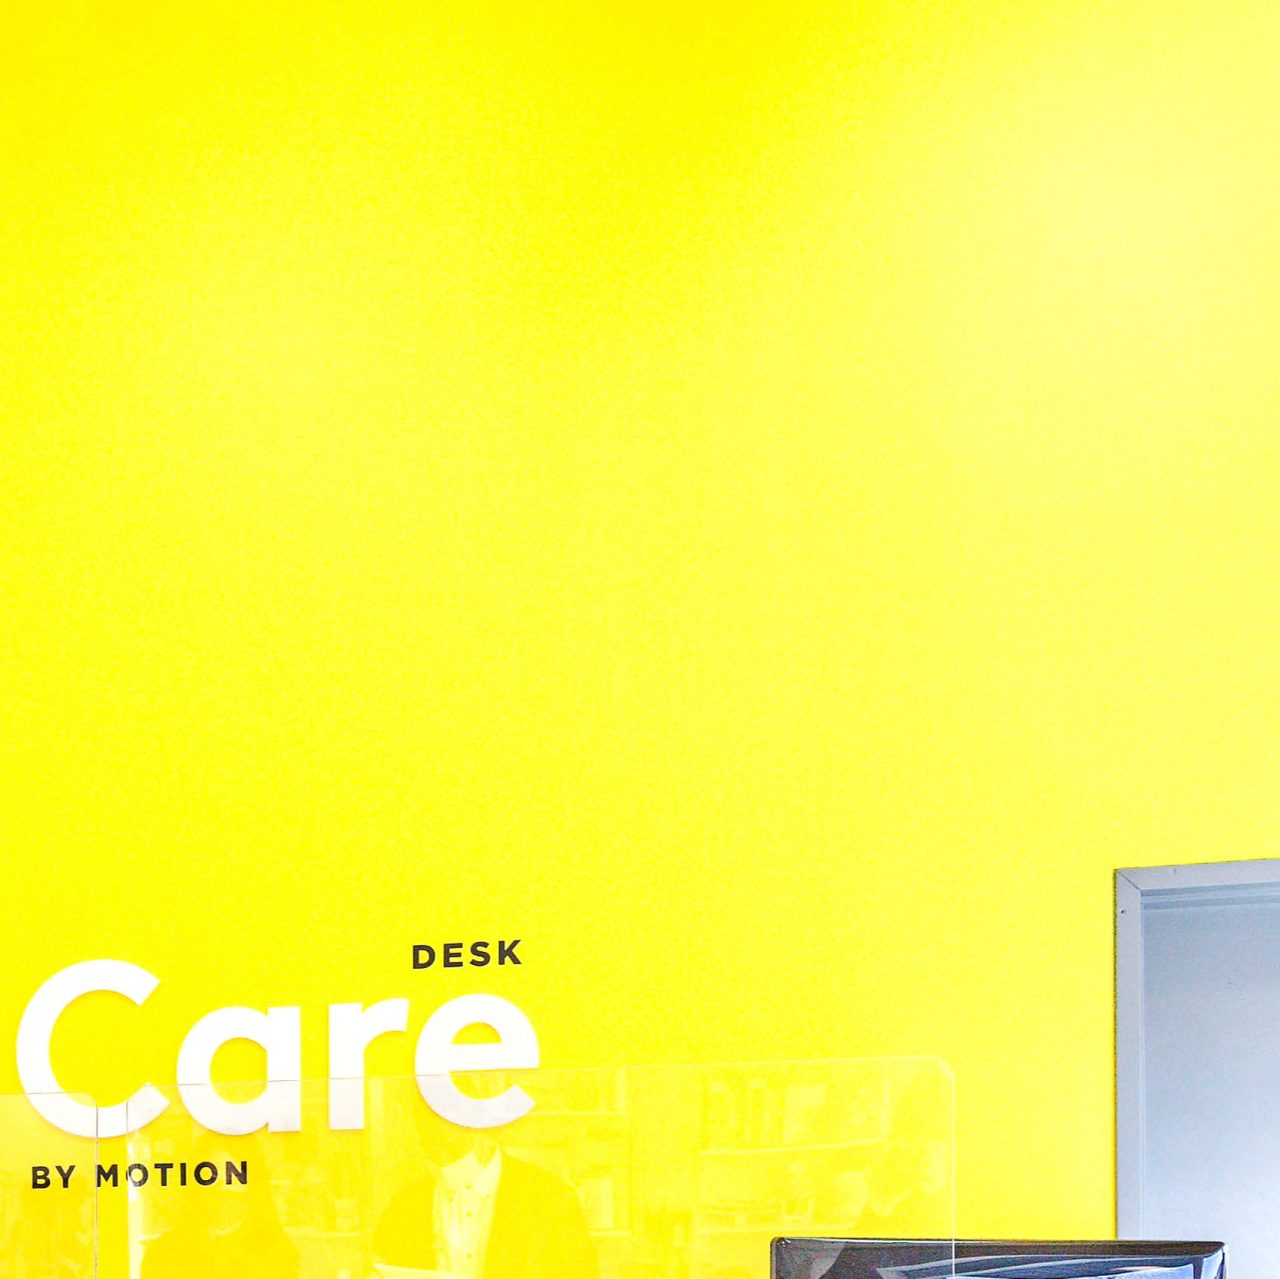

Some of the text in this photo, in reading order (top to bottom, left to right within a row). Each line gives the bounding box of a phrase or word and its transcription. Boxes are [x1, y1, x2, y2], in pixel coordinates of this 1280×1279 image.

[412, 939, 523, 970] DESK
[15, 958, 541, 1139] Care
[31, 1160, 249, 1190] BY MOTION
